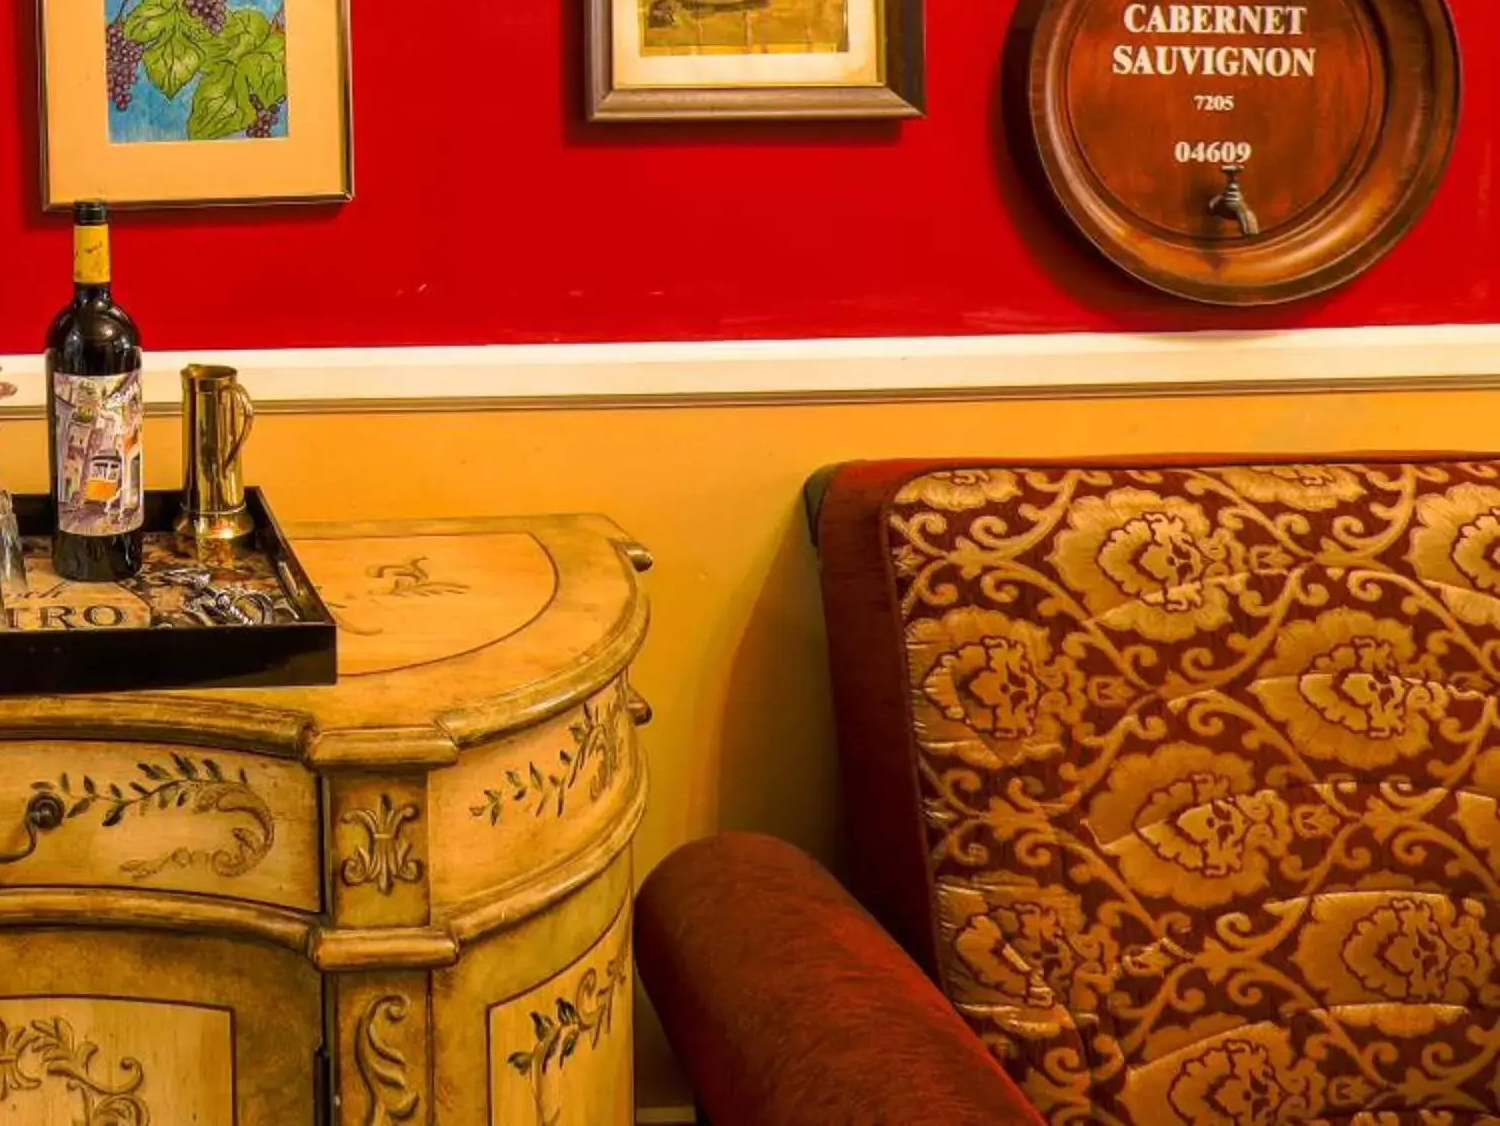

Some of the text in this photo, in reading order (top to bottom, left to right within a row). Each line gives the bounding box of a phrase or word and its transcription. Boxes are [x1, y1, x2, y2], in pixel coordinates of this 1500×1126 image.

[1123, 3, 1308, 35] CABERNET
[1112, 44, 1317, 77] SAUVIGNON
[1193, 94, 1235, 111] 7205
[1174, 141, 1252, 163] 04609
